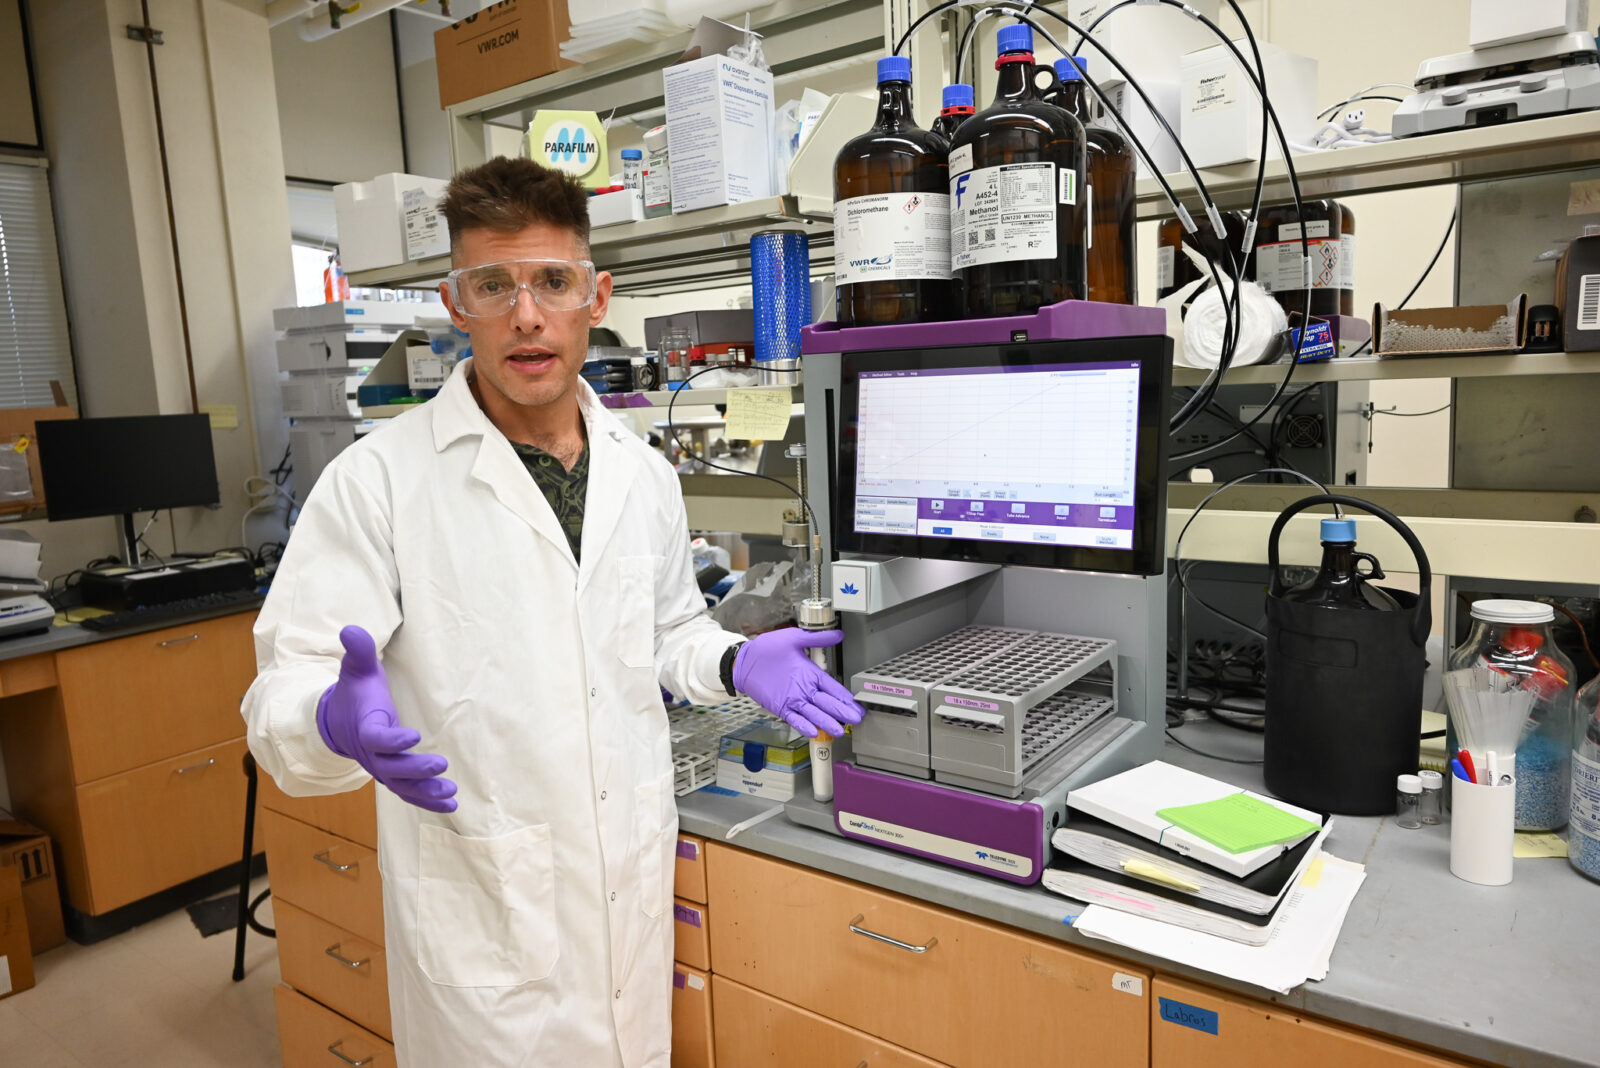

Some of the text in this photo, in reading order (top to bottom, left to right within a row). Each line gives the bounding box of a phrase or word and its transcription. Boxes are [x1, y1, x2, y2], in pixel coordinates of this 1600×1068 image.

[477, 28, 519, 54] VWR.COM
[544, 142, 595, 153] PARAFILM
[976, 190, 998, 200] A452-4
[847, 206, 889, 216] Dichloromethane
[969, 205, 998, 216] Methanol
[849, 258, 870, 268] VWR
[1318, 331, 1330, 341] 75
